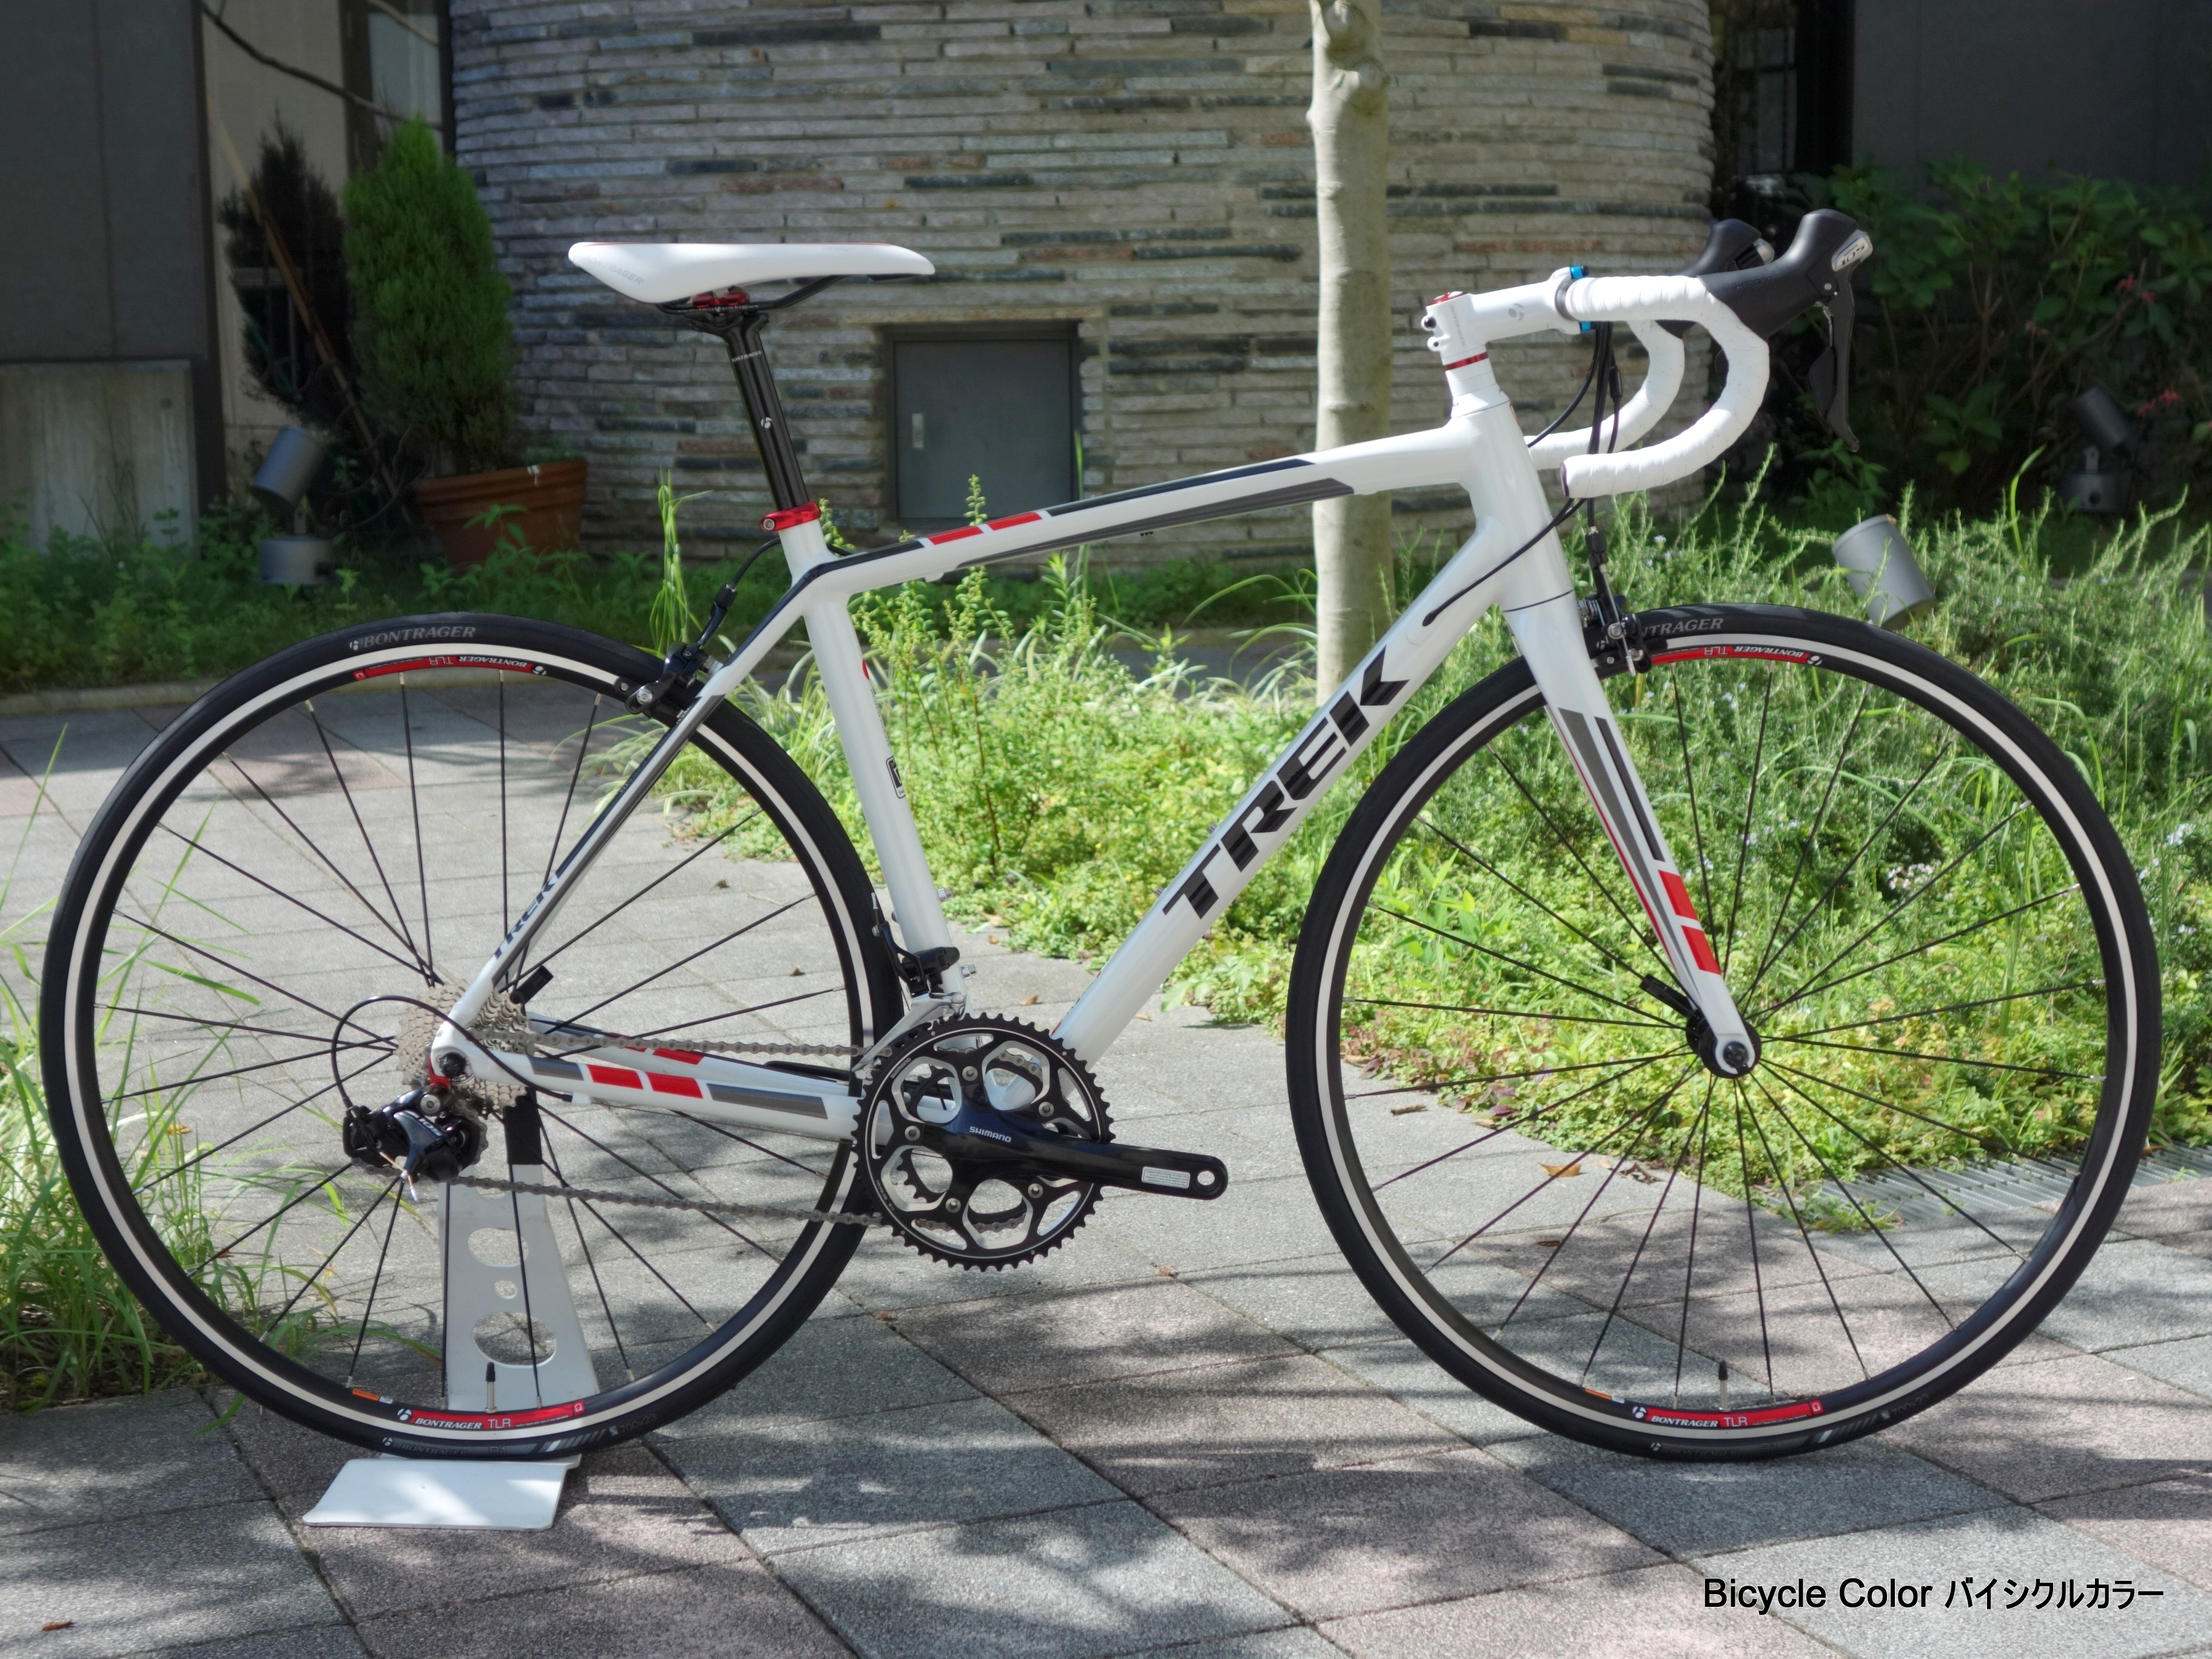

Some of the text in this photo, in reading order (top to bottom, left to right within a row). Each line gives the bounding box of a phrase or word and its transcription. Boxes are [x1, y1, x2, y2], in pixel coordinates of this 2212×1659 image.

[364, 626, 476, 648] BONTRAGER
[1703, 646, 1728, 655] TLR
[1734, 646, 1805, 658] BONTRAGER
[427, 656, 454, 666] TLR
[458, 655, 528, 668] BONTRAGER
[1162, 645, 1410, 920] TREK
[890, 1057, 911, 1079] SHIMANO
[969, 1126, 1012, 1143] SHIMANO
[415, 1418, 483, 1429] BONTRAGER
[487, 1418, 511, 1429] TLR
[1651, 1415, 1718, 1427] BONTRAGER
[1723, 1416, 1748, 1427] TLR
